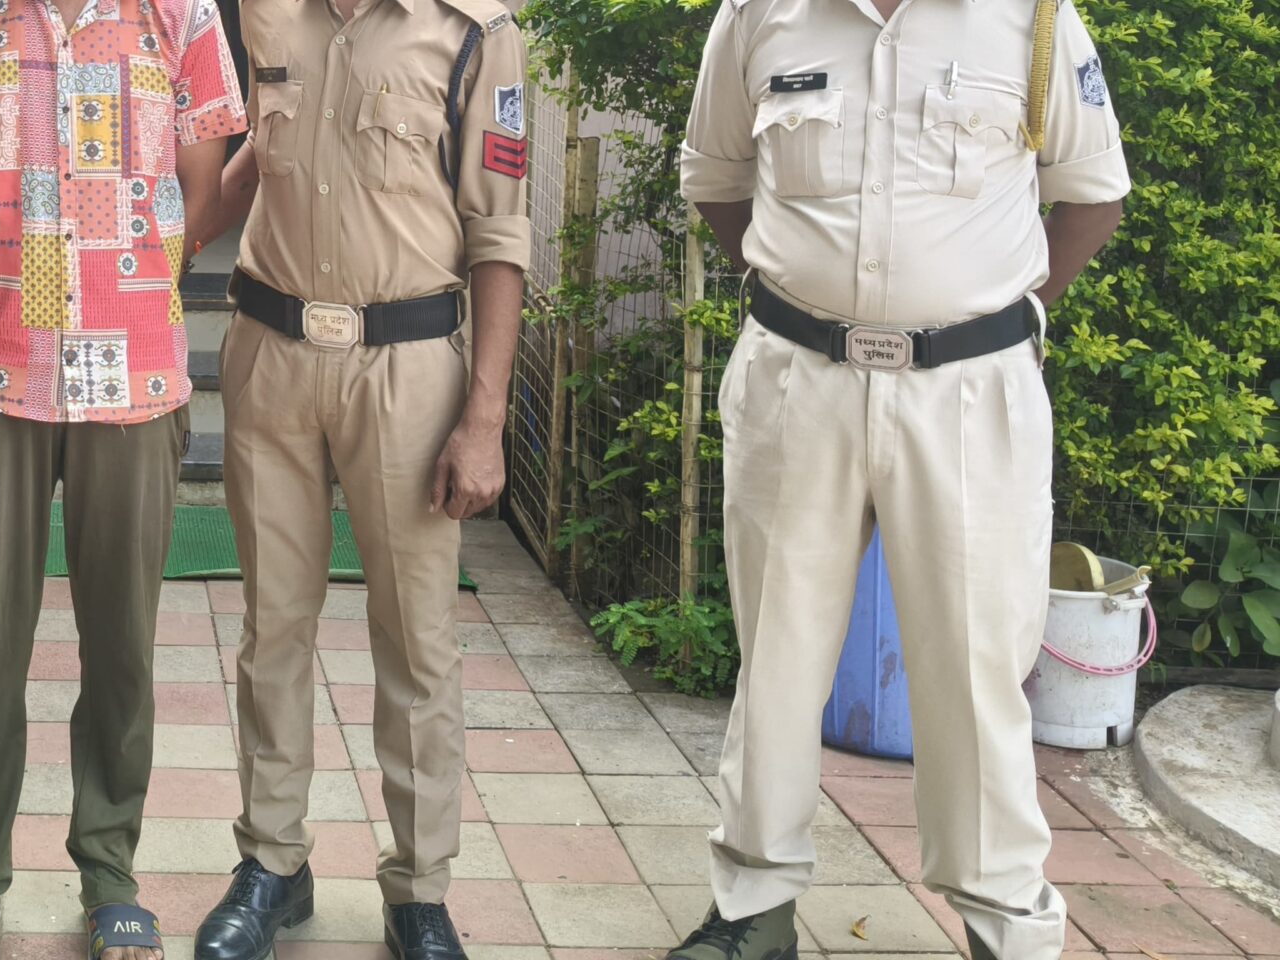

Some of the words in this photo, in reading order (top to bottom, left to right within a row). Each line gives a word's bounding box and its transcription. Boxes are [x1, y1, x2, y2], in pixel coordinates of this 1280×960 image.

[329, 315, 350, 326] प्रदेश
[317, 324, 343, 338] पुलिस
[877, 338, 904, 350] प्रदेश
[863, 349, 895, 361] पुलिस
